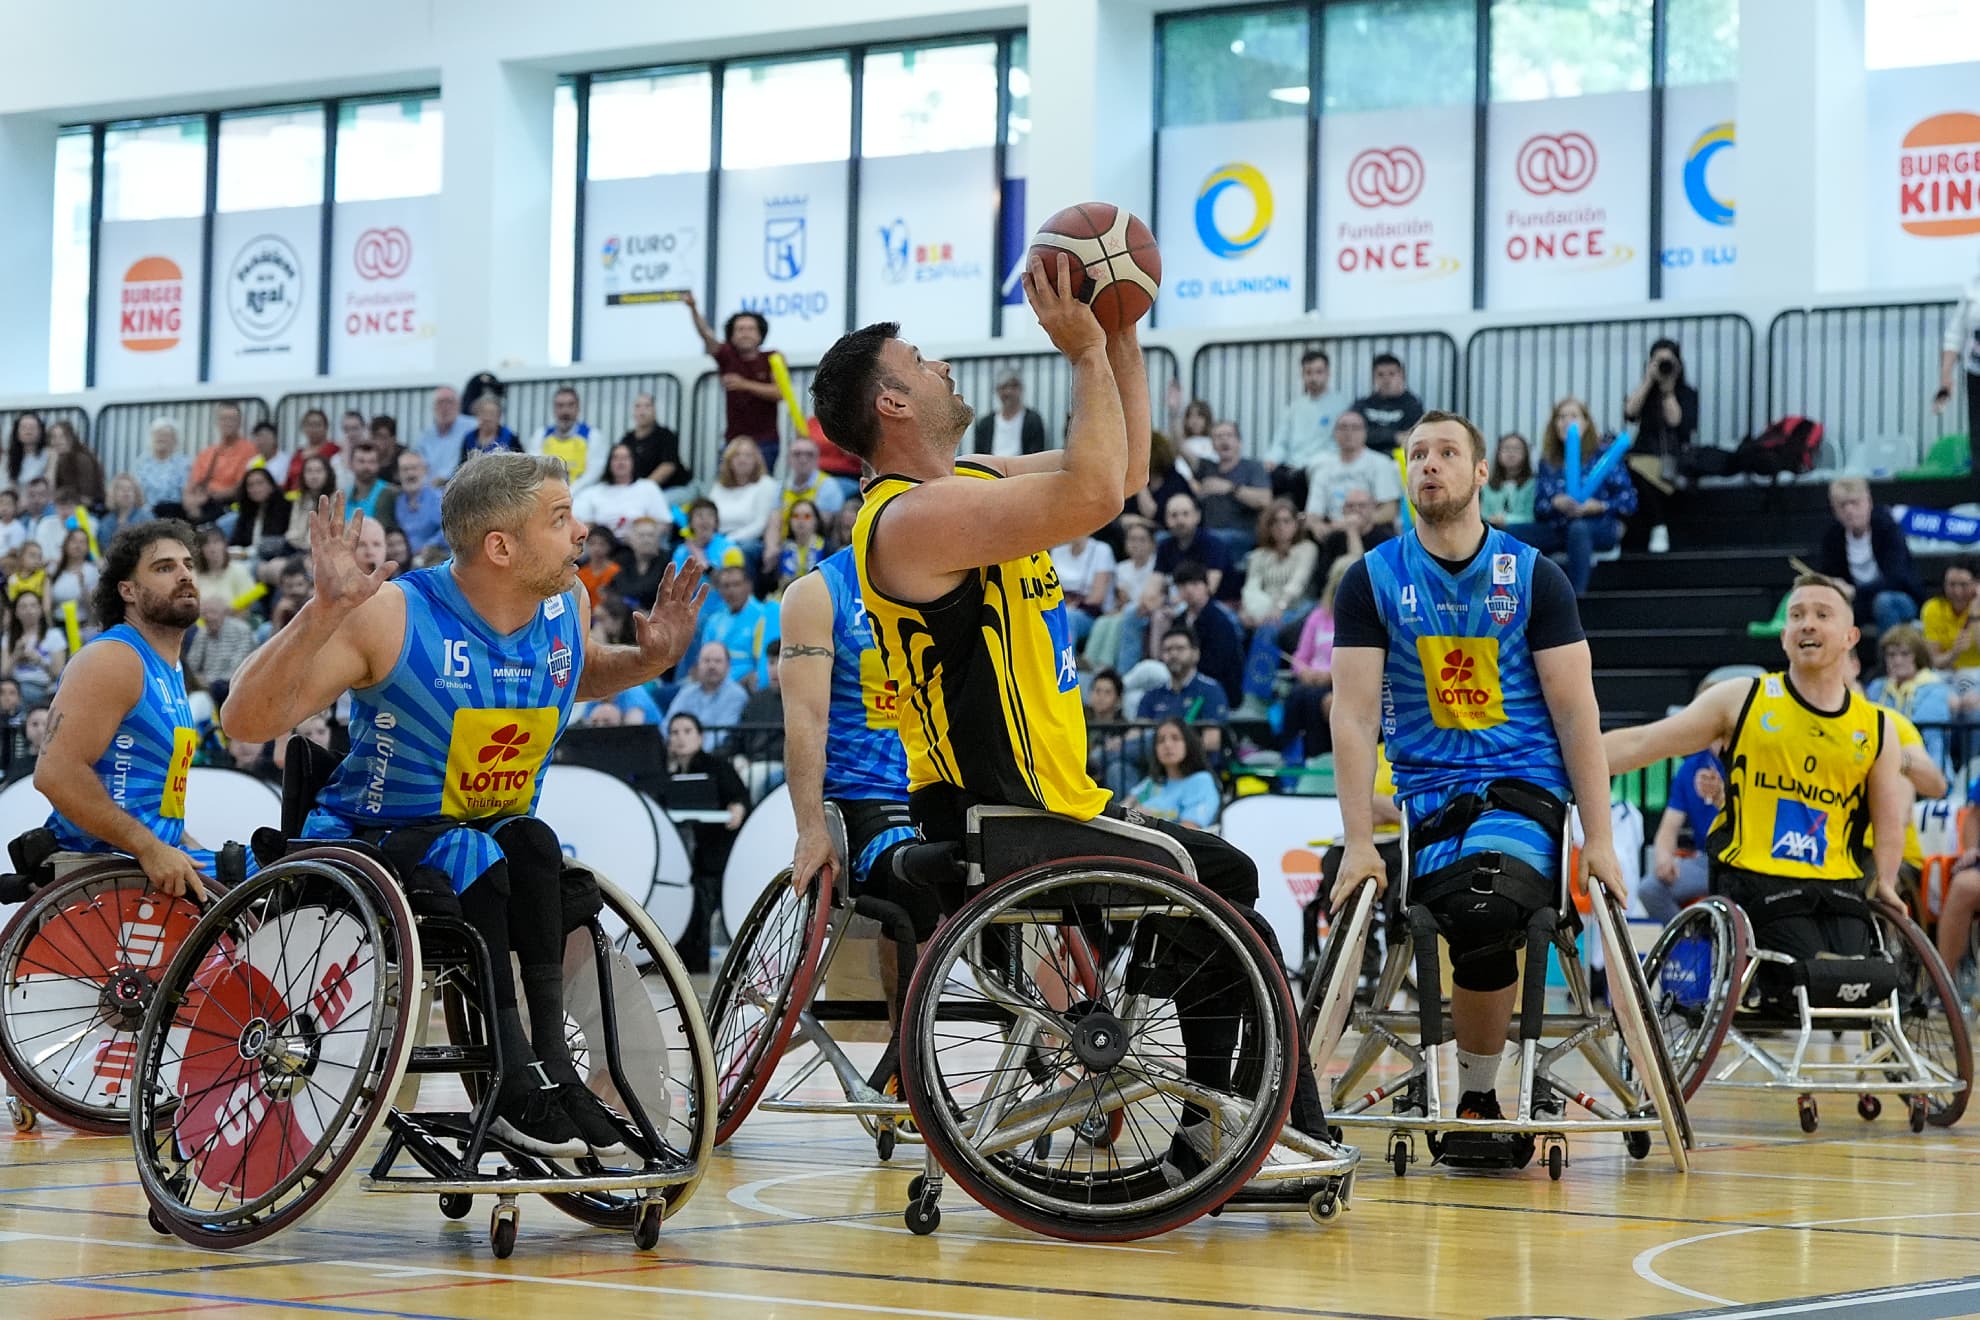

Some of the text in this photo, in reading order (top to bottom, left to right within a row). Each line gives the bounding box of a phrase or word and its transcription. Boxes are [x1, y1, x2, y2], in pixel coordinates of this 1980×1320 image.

[1902, 179, 1980, 214] KIN
[627, 234, 676, 255] EURO
[1338, 241, 1430, 272] ONCE
[1507, 230, 1603, 260] ONCE
[631, 262, 669, 283] CUP
[121, 286, 182, 304] BURGER
[1175, 279, 1203, 298] CD
[741, 291, 829, 320] MADRID
[120, 307, 182, 333] KING
[345, 309, 415, 335] ONCE
[1401, 584, 1417, 613] 4
[443, 638, 470, 678] 15
[550, 655, 572, 674] BULLS
[493, 668, 532, 678] MMVIII
[1434, 688, 1489, 705] LOTTO
[366, 733, 394, 814] JÜTTNER
[460, 770, 529, 793] LOTTO
[1920, 804, 1949, 833] 14
[1771, 830, 1818, 863] AXA
